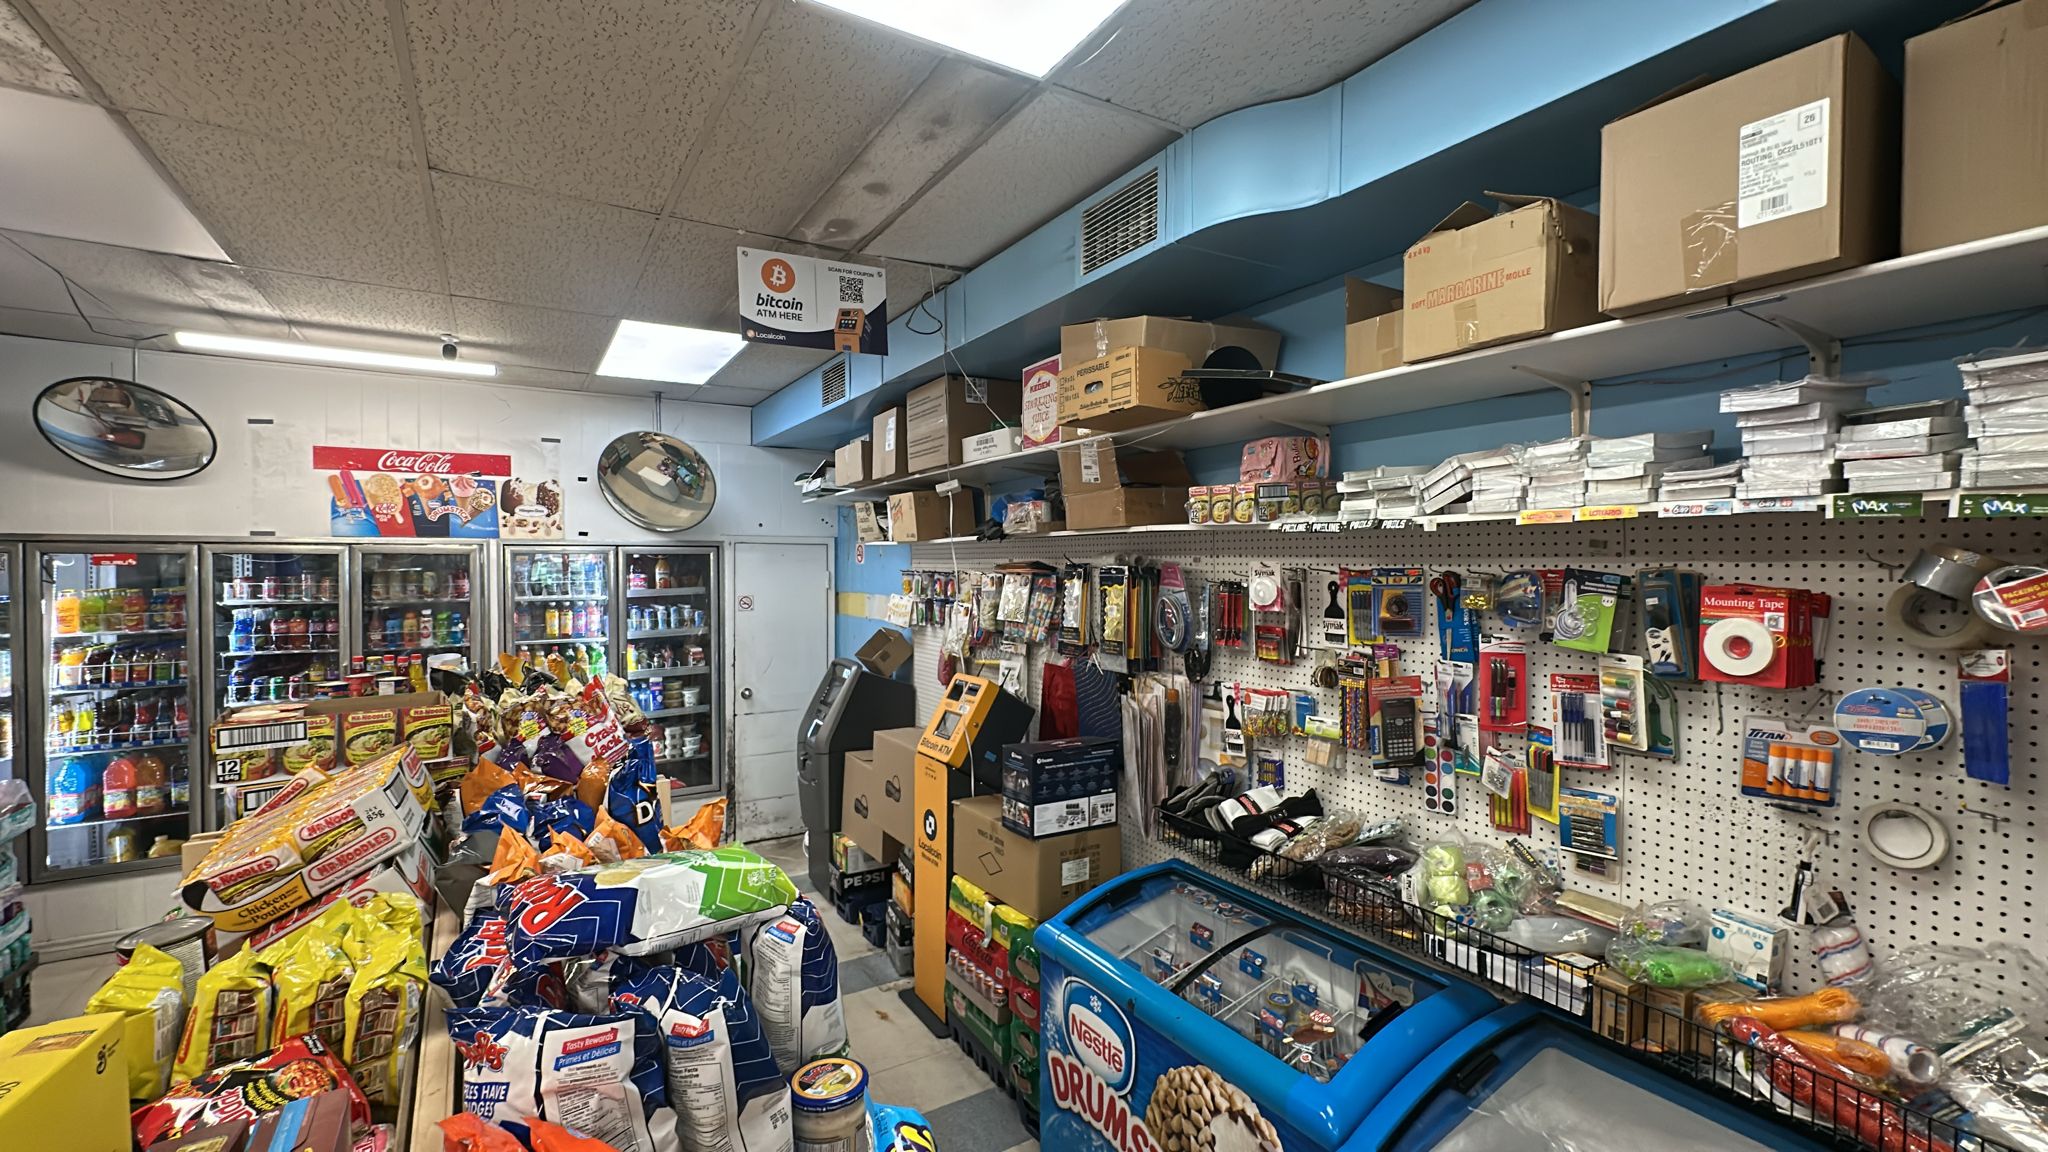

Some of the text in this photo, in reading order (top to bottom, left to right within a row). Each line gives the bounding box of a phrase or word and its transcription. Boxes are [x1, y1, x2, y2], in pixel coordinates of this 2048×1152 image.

[853, 269, 875, 278] COUPON
[1426, 268, 1504, 309] MARGARINE
[1505, 267, 1532, 281] MOLLE
[756, 293, 804, 311] bitcoin
[756, 309, 803, 321] ATM HERE
[755, 331, 787, 342] Localcoin
[1030, 380, 1051, 393] KEDEM
[377, 451, 454, 473] Coca-Cola
[429, 505, 471, 522] DRUMSTICK
[1704, 596, 1785, 611] Mounting Tape
[1748, 728, 1787, 741] TITAN
[591, 734, 624, 760] Jack
[921, 737, 953, 756] Bitcoin ATM
[218, 760, 239, 774] 12
[366, 810, 385, 821] 85g
[919, 838, 942, 861] Localcoin
[844, 871, 886, 889] PEPSI
[238, 892, 287, 918] Chicken
[250, 902, 291, 923] Poulet
[566, 1032, 614, 1051] Tasty Rewards
[1070, 1013, 1124, 1074] Nestlé
[558, 1045, 617, 1067] Primes et Délices
[482, 1083, 507, 1099] HAVE
